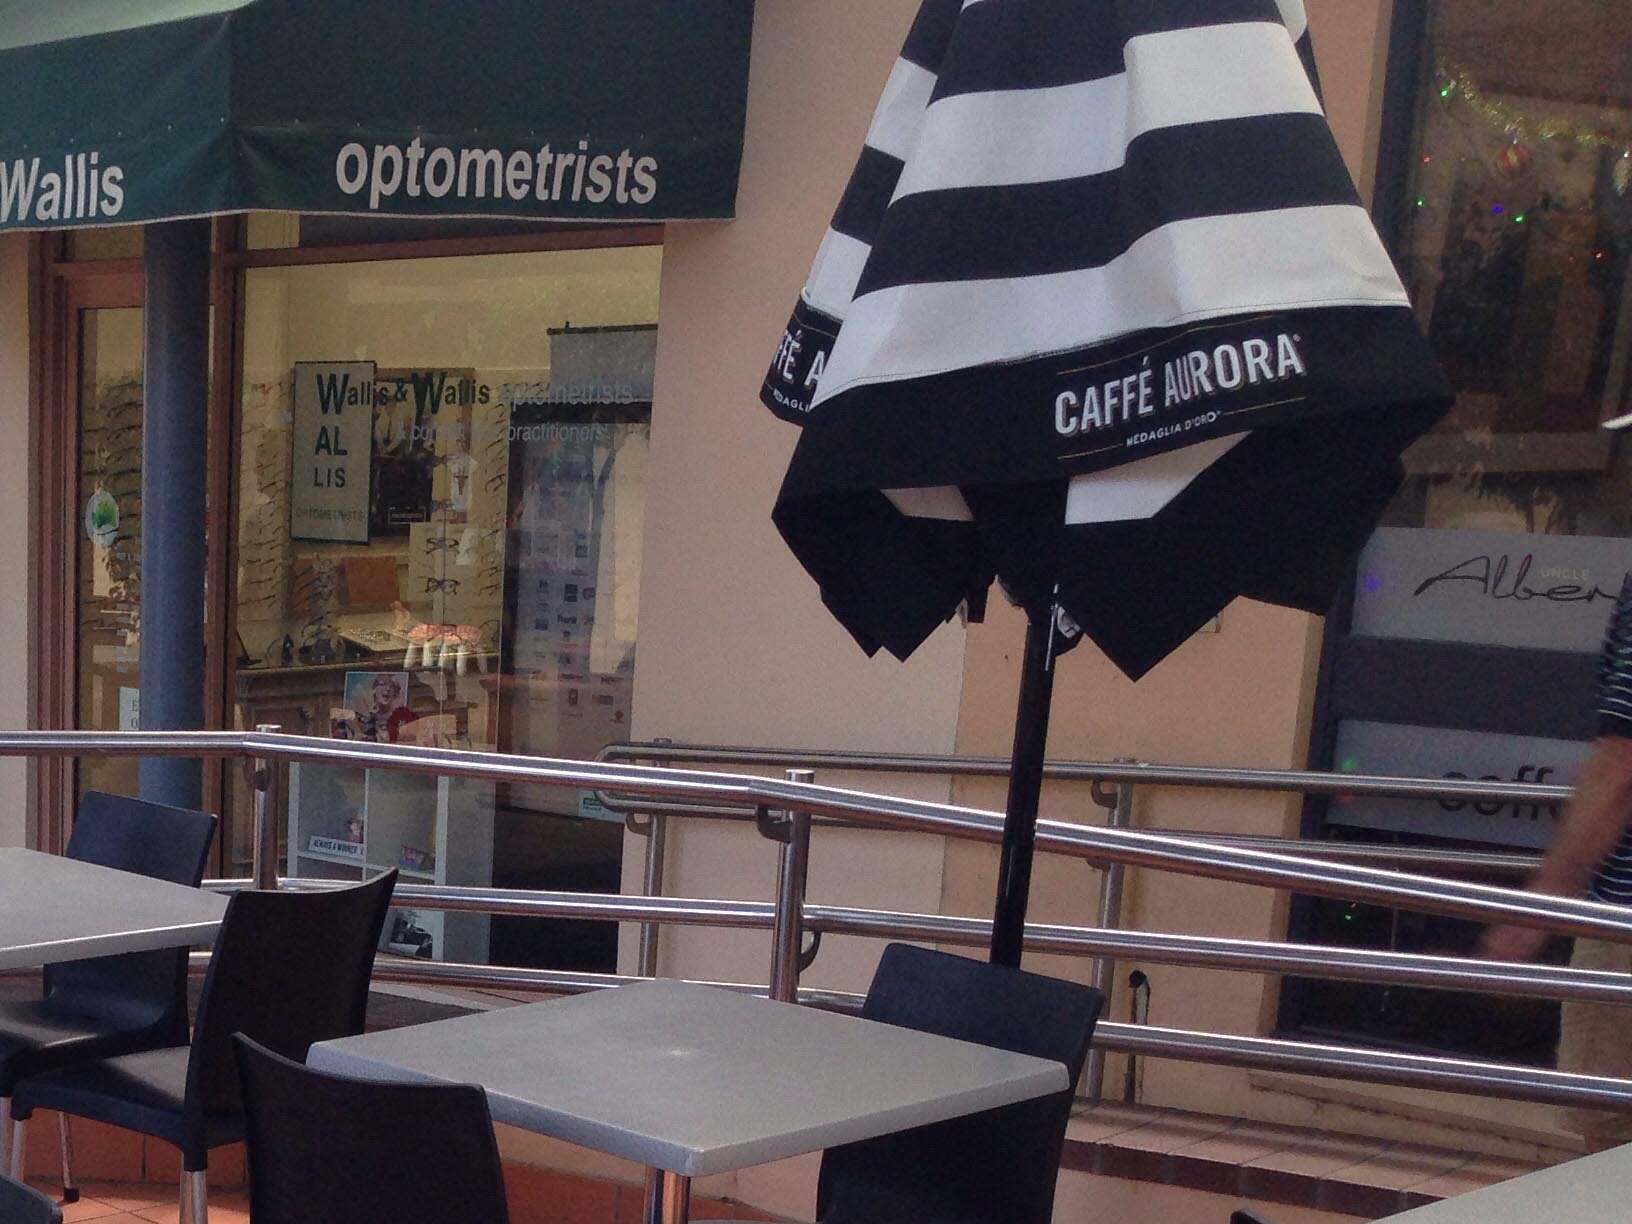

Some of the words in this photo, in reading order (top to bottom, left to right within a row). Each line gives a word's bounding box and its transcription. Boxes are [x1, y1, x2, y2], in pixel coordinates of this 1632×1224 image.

[335, 136, 659, 209] optometrists
[393, 381, 408, 402] &
[412, 372, 490, 415] Wallis
[1053, 355, 1156, 435] CAFFÉ
[1164, 333, 1307, 404] AURORA
[314, 425, 347, 456] AL
[1126, 423, 1181, 447] MEDAGLIA
[314, 466, 346, 488] LIS
[1414, 554, 1618, 603] Alber
[1438, 764, 1558, 820] coff
